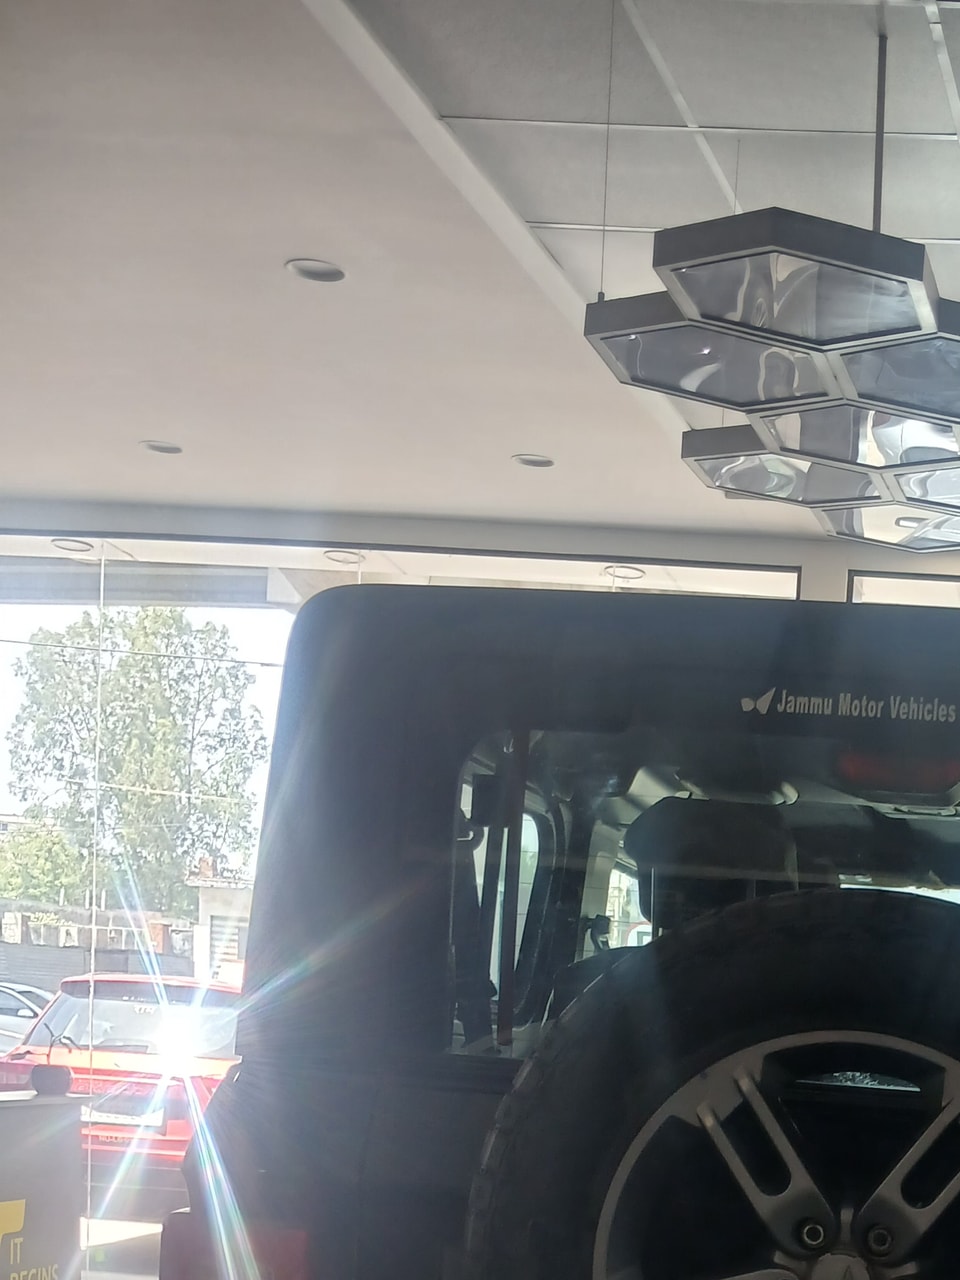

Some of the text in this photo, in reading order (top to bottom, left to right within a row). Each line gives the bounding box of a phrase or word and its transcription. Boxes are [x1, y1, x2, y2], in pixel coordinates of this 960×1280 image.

[777, 689, 832, 715] Jammu
[838, 692, 885, 718] Motor
[890, 695, 957, 722] Vehicles
[9, 1237, 24, 1265] IT
